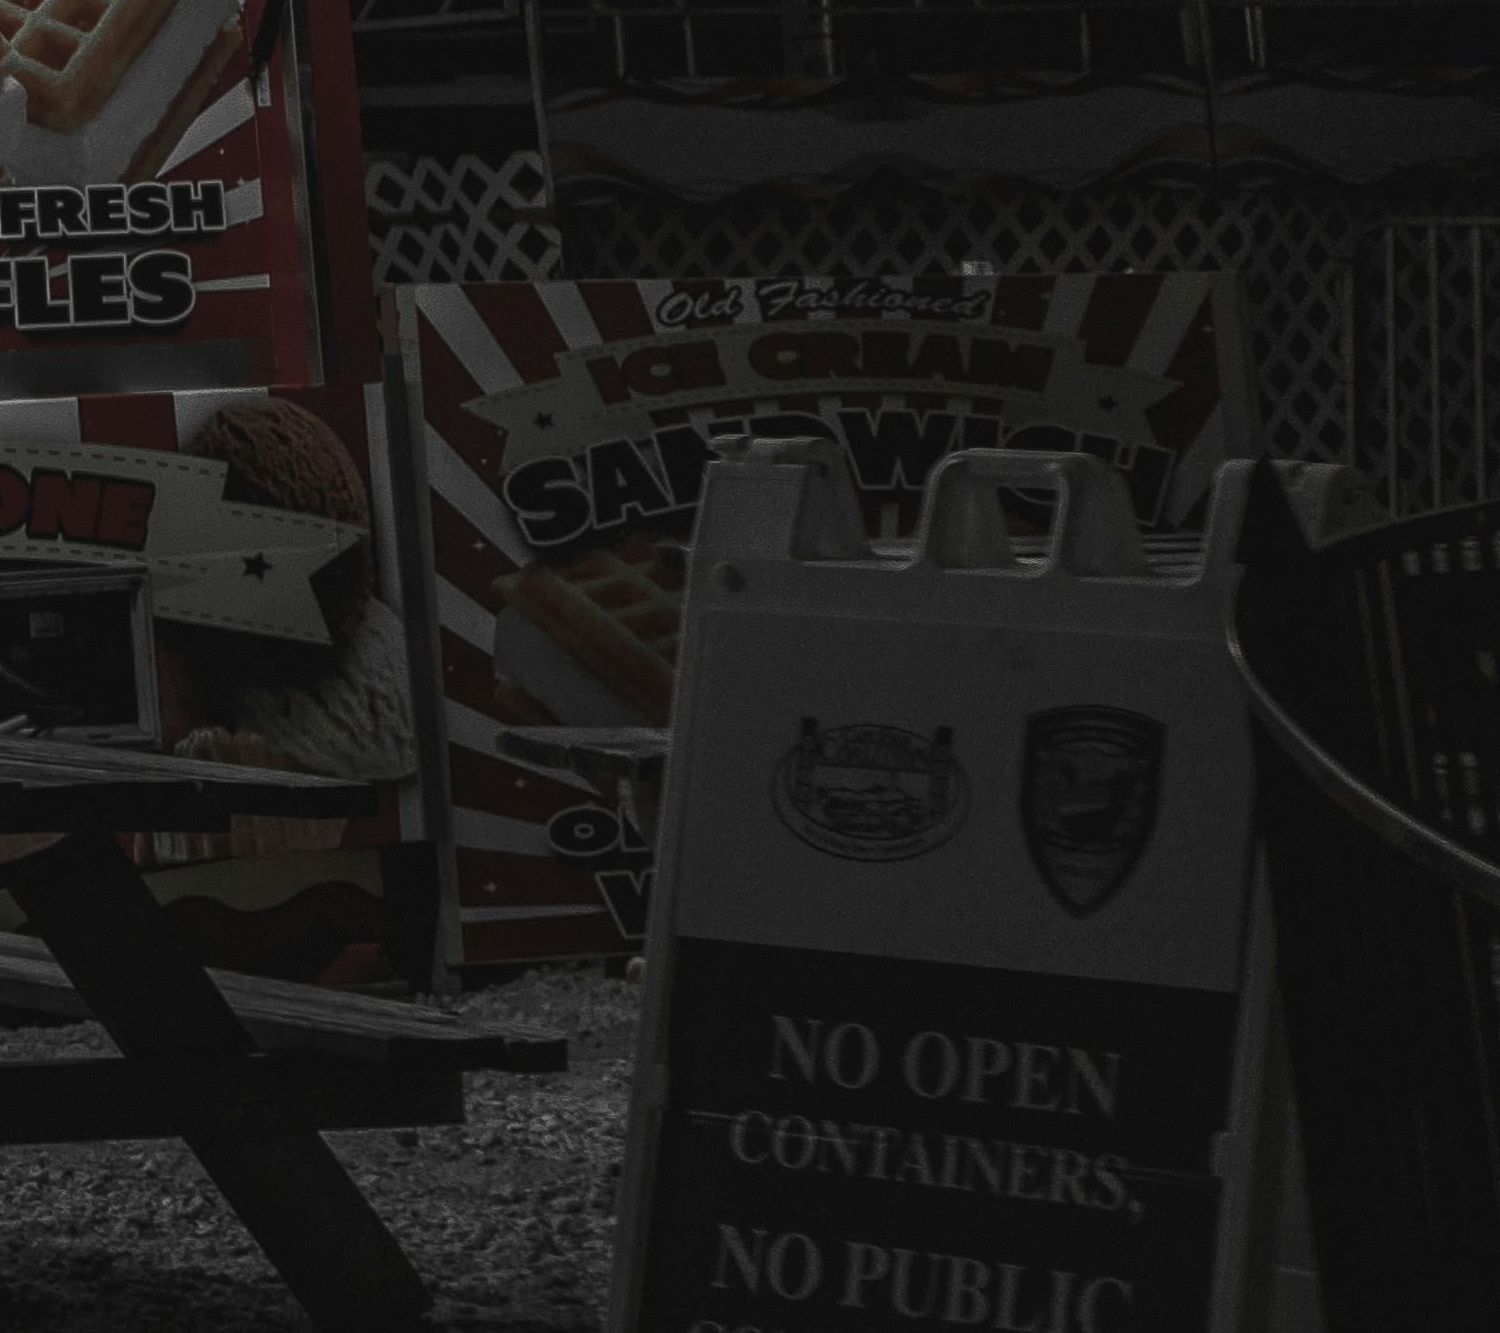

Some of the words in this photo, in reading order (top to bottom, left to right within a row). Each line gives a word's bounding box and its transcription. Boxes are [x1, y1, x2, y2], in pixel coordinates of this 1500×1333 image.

[657, 289, 744, 328] Old
[759, 280, 989, 321] Fashioned
[586, 343, 726, 405] ICE
[749, 331, 1055, 392] CREAM
[768, 1013, 879, 1089] NO
[903, 1030, 1123, 1119] OPEN
[730, 1110, 1146, 1226] CONTAINERS,
[710, 1223, 823, 1300] NO
[839, 1240, 1135, 1333] PUBLIC
